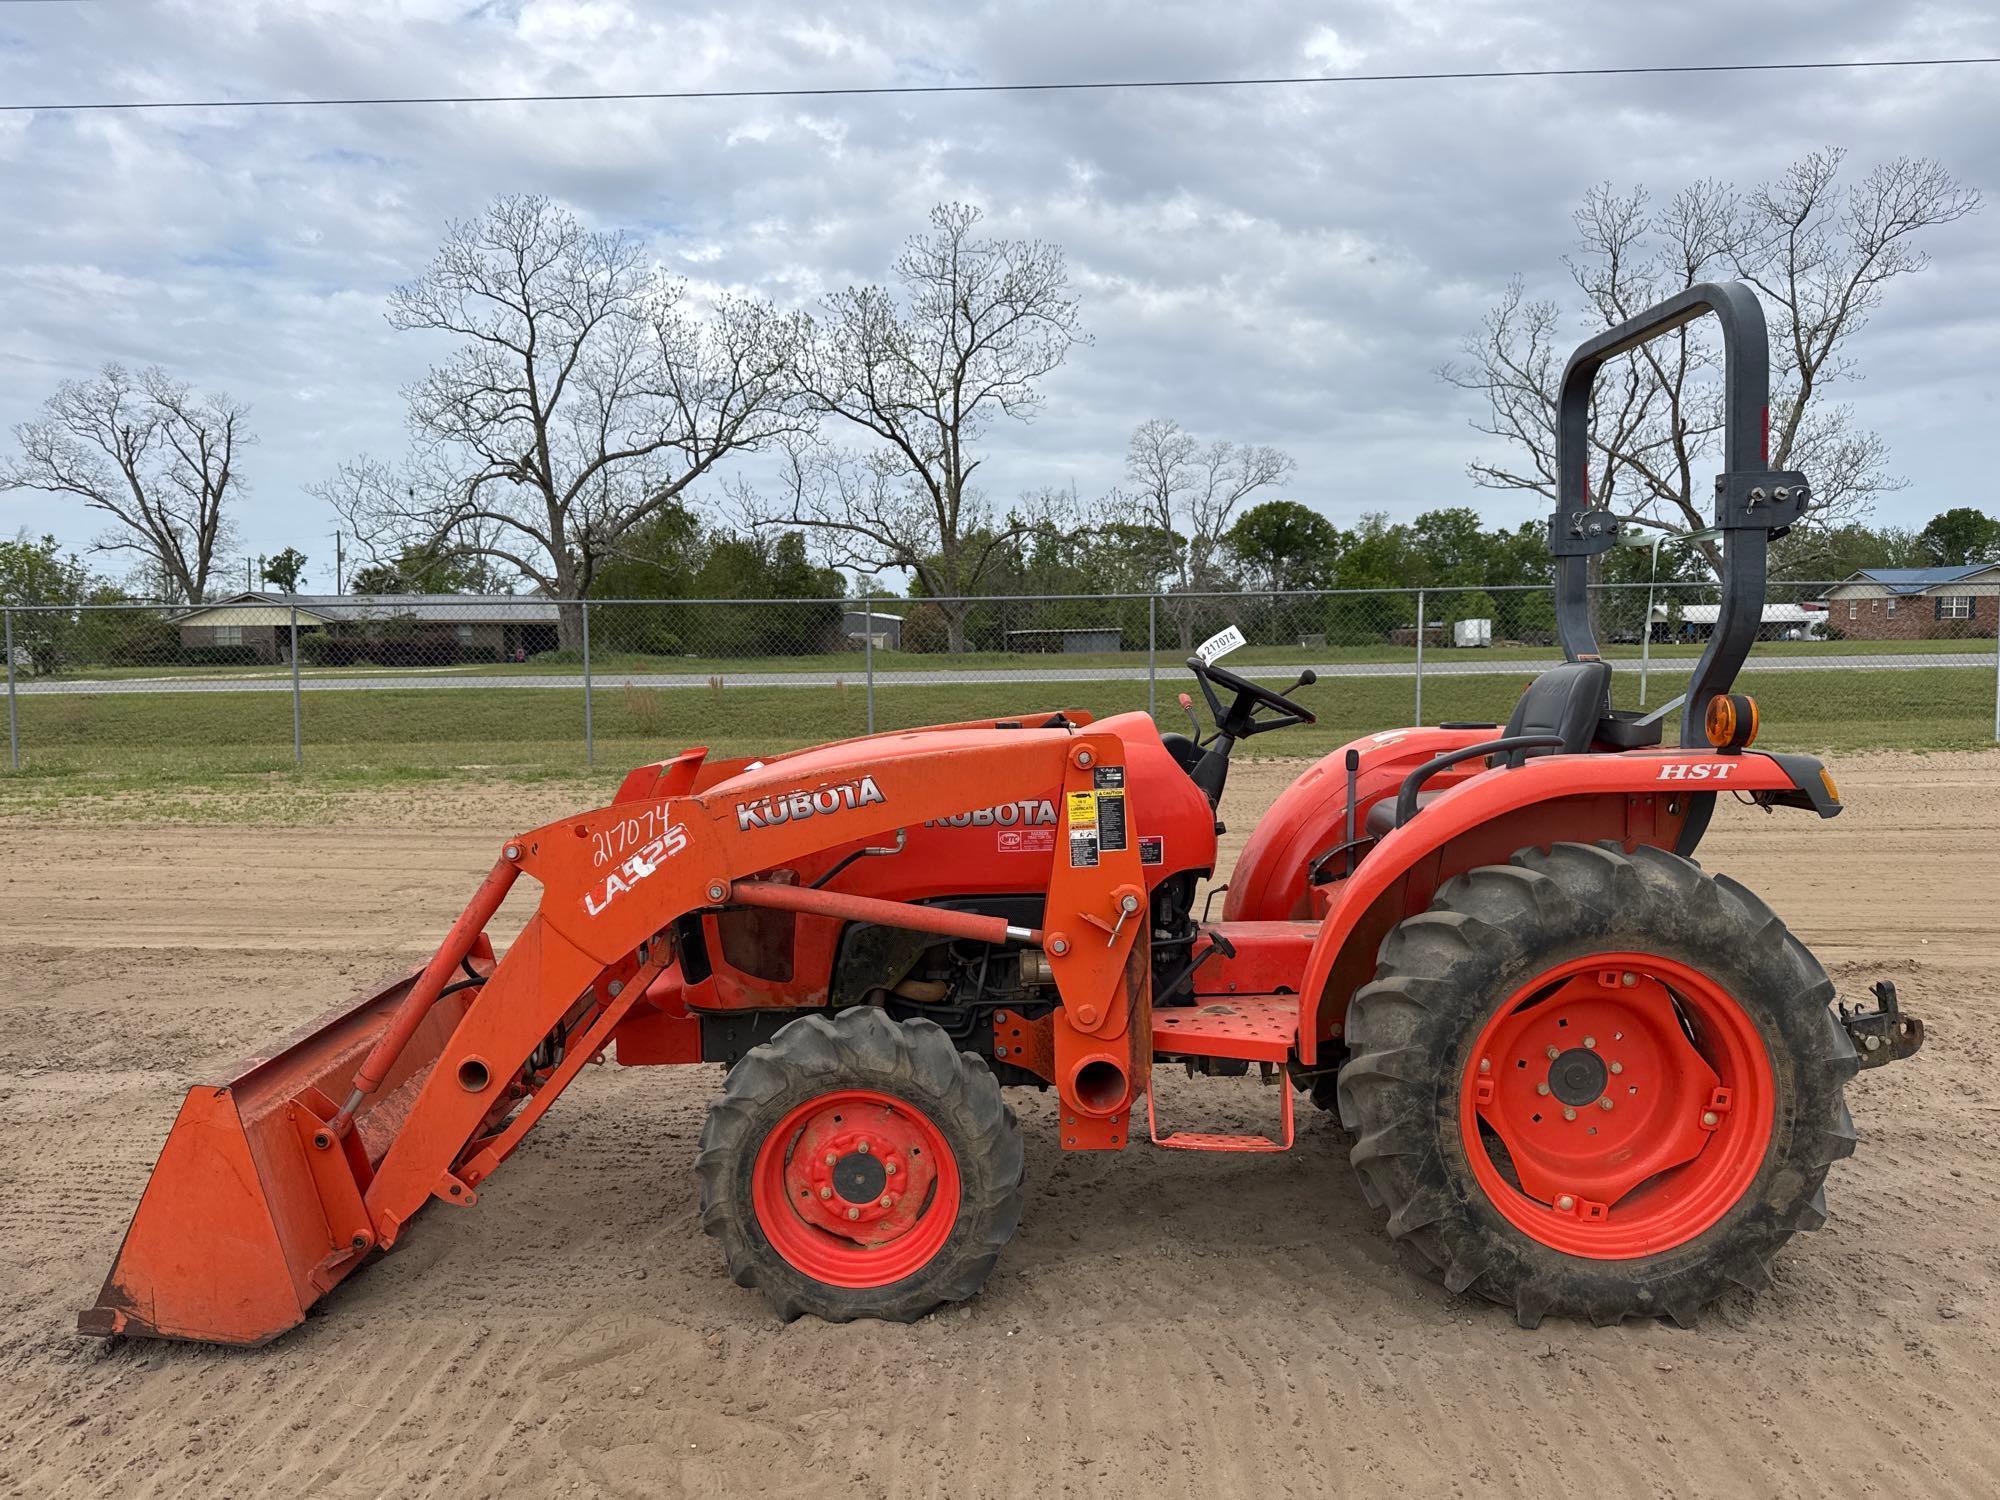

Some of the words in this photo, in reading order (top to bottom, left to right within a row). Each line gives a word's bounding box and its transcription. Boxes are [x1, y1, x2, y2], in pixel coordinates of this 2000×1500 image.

[1204, 632, 1236, 655] 217074
[1656, 763, 1738, 780] HST
[736, 775, 885, 831] KUBOTA
[592, 802, 670, 867] 217074
